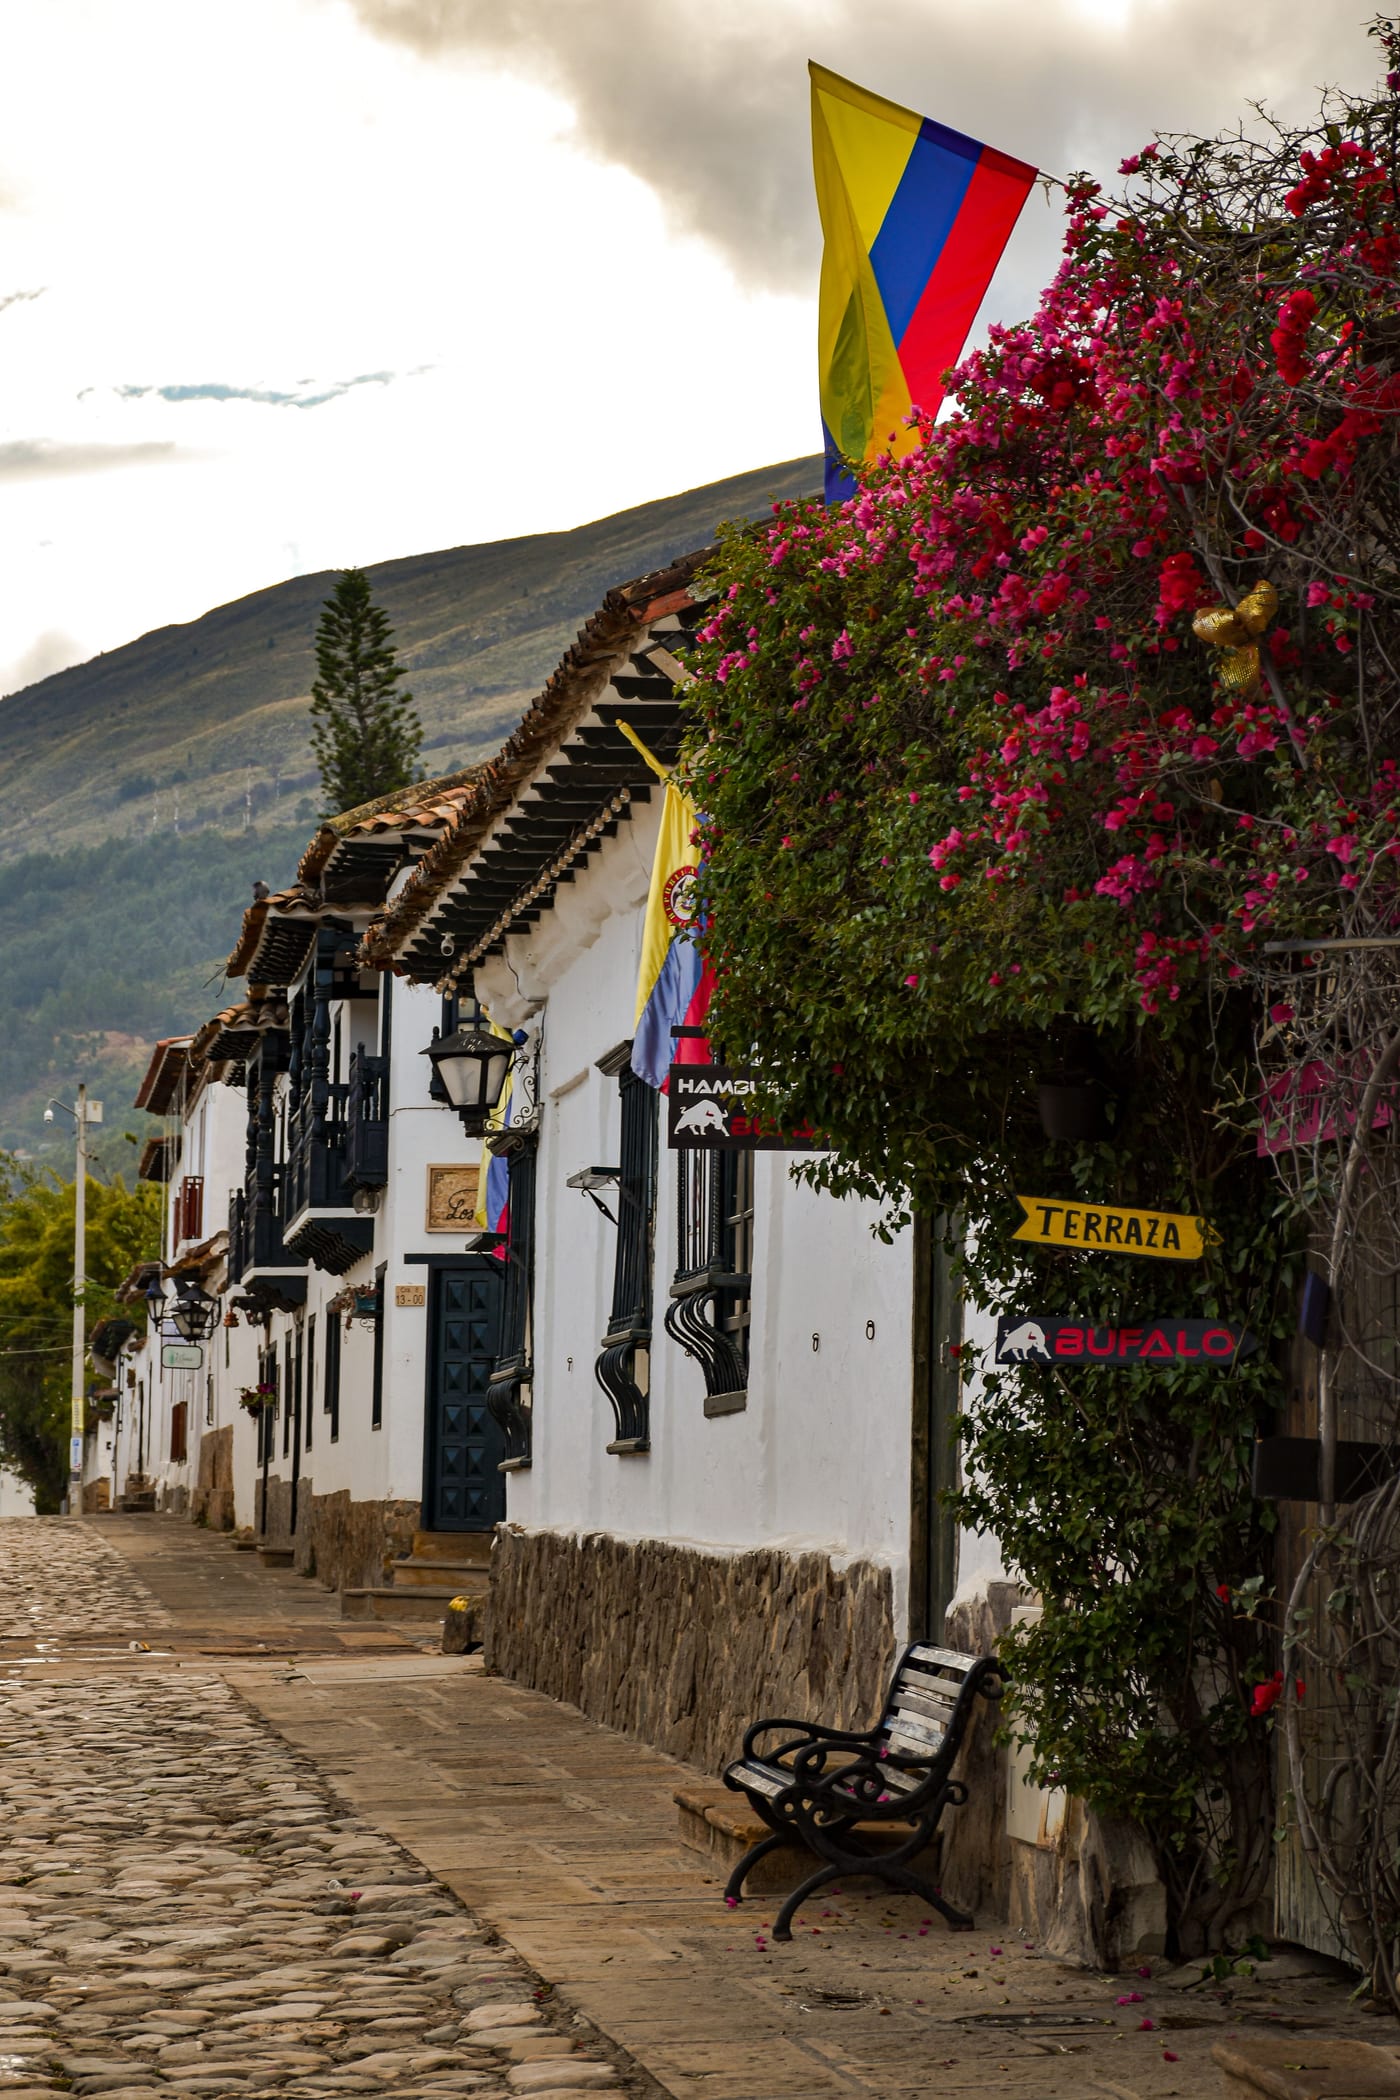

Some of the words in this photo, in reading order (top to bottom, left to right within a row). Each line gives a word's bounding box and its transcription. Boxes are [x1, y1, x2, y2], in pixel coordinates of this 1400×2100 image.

[446, 1191, 475, 1221] Los
[1035, 1205, 1181, 1250] TERRAZA
[1055, 1327, 1235, 1357] BUFALO
